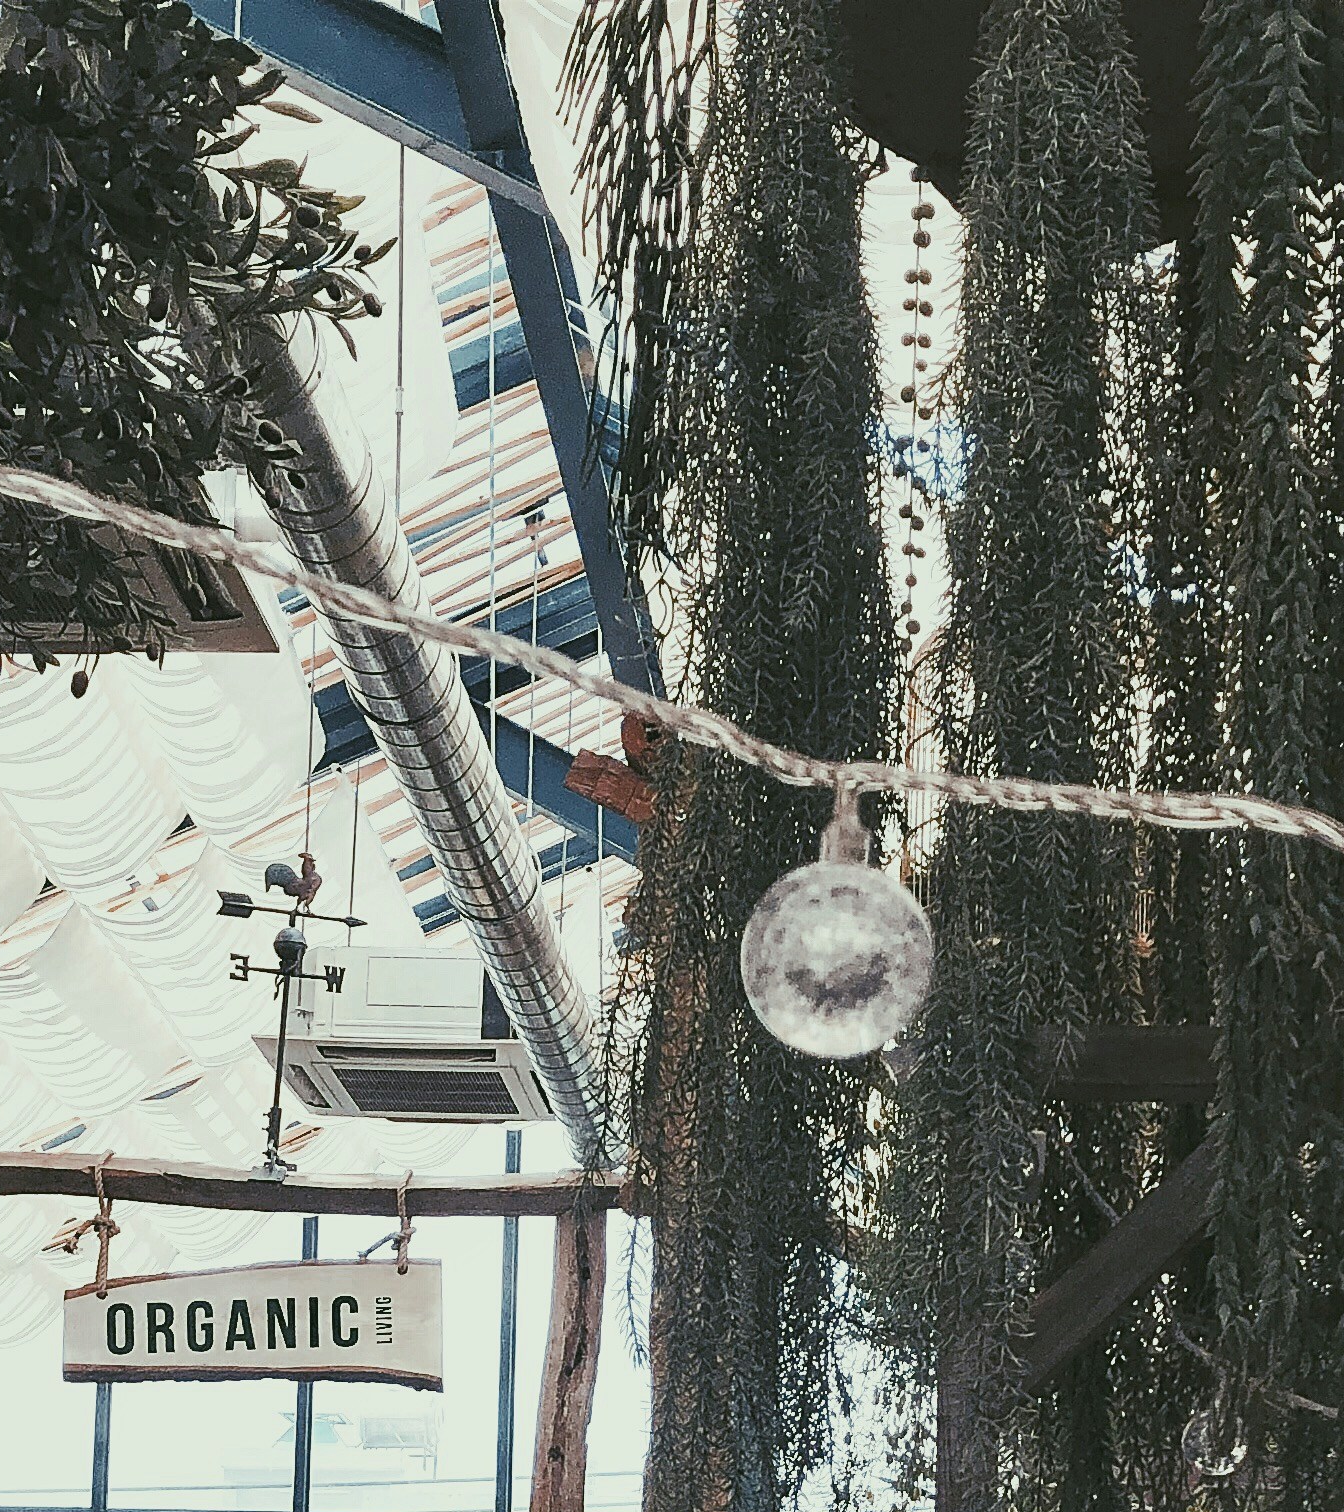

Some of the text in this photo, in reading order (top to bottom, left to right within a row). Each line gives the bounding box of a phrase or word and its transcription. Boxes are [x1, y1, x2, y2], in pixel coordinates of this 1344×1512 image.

[323, 965, 346, 993] W
[106, 1295, 359, 1355] ORGANIC
[375, 1295, 393, 1344] LIVING
